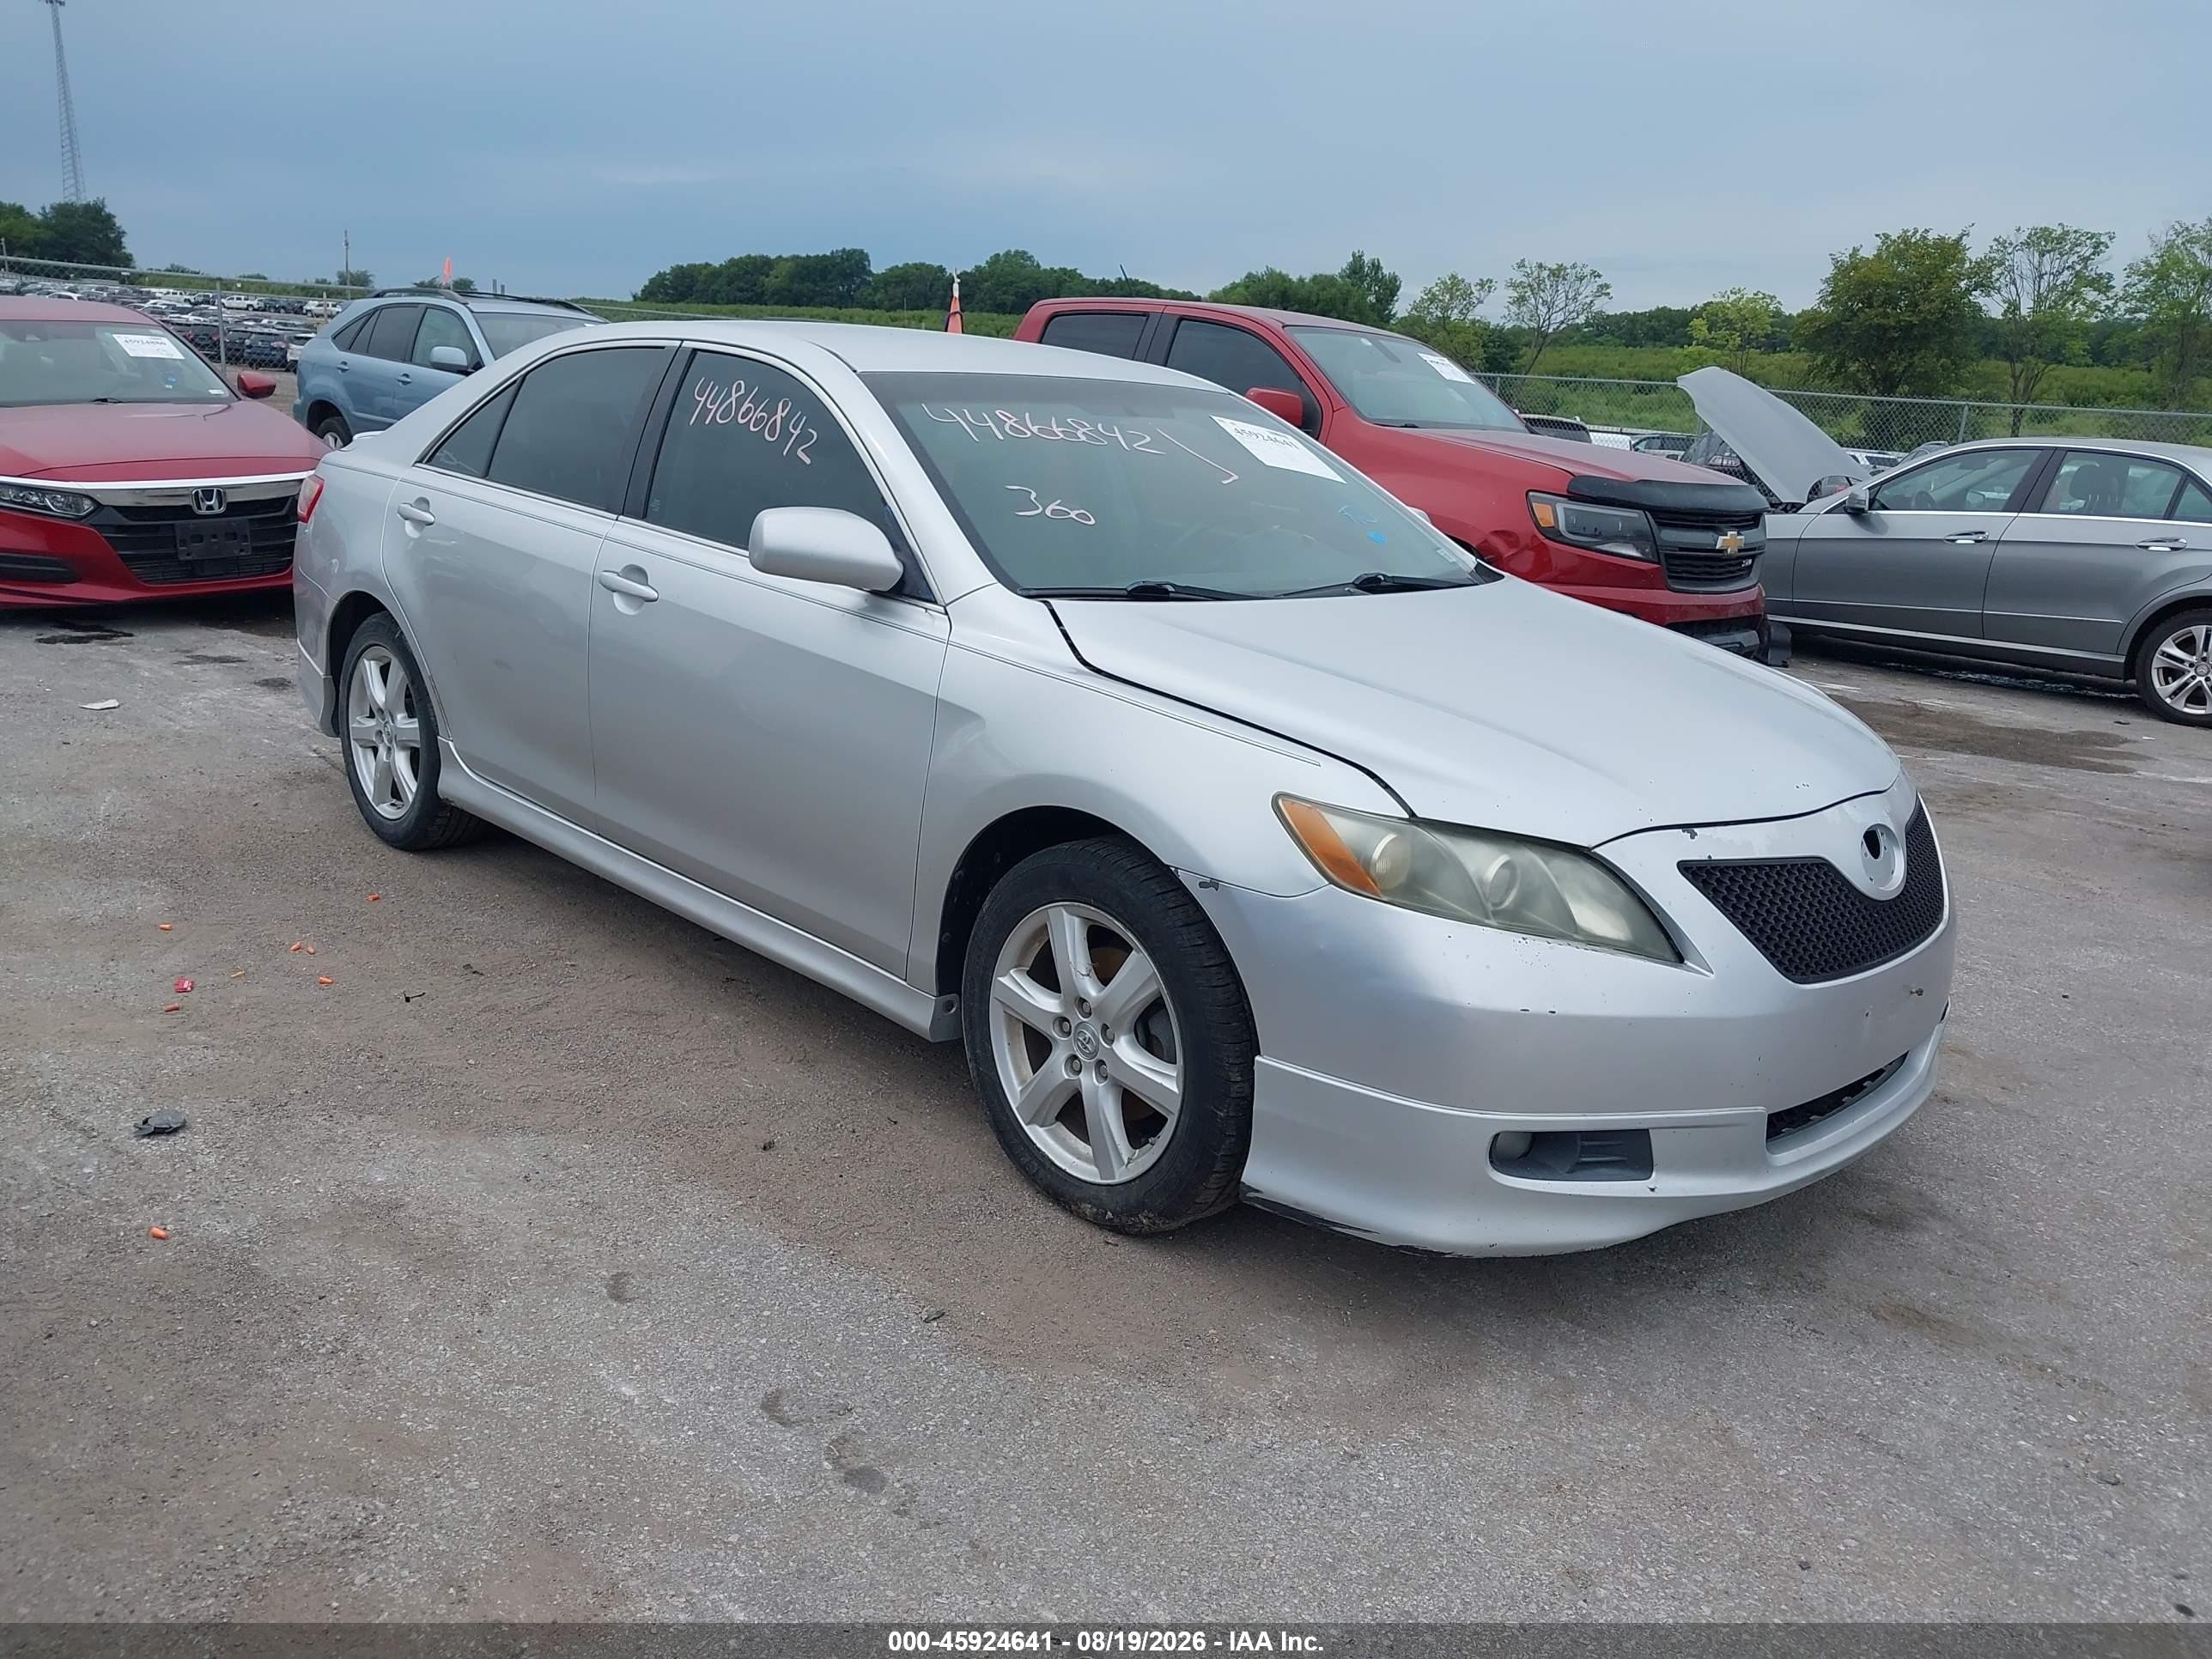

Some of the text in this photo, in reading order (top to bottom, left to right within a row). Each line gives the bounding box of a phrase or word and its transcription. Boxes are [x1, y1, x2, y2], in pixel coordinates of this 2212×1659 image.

[690, 377, 817, 465] 44866842
[921, 403, 1166, 455] 44866842
[1233, 427, 1300, 450] 45924641
[1004, 484, 1097, 526] 360
